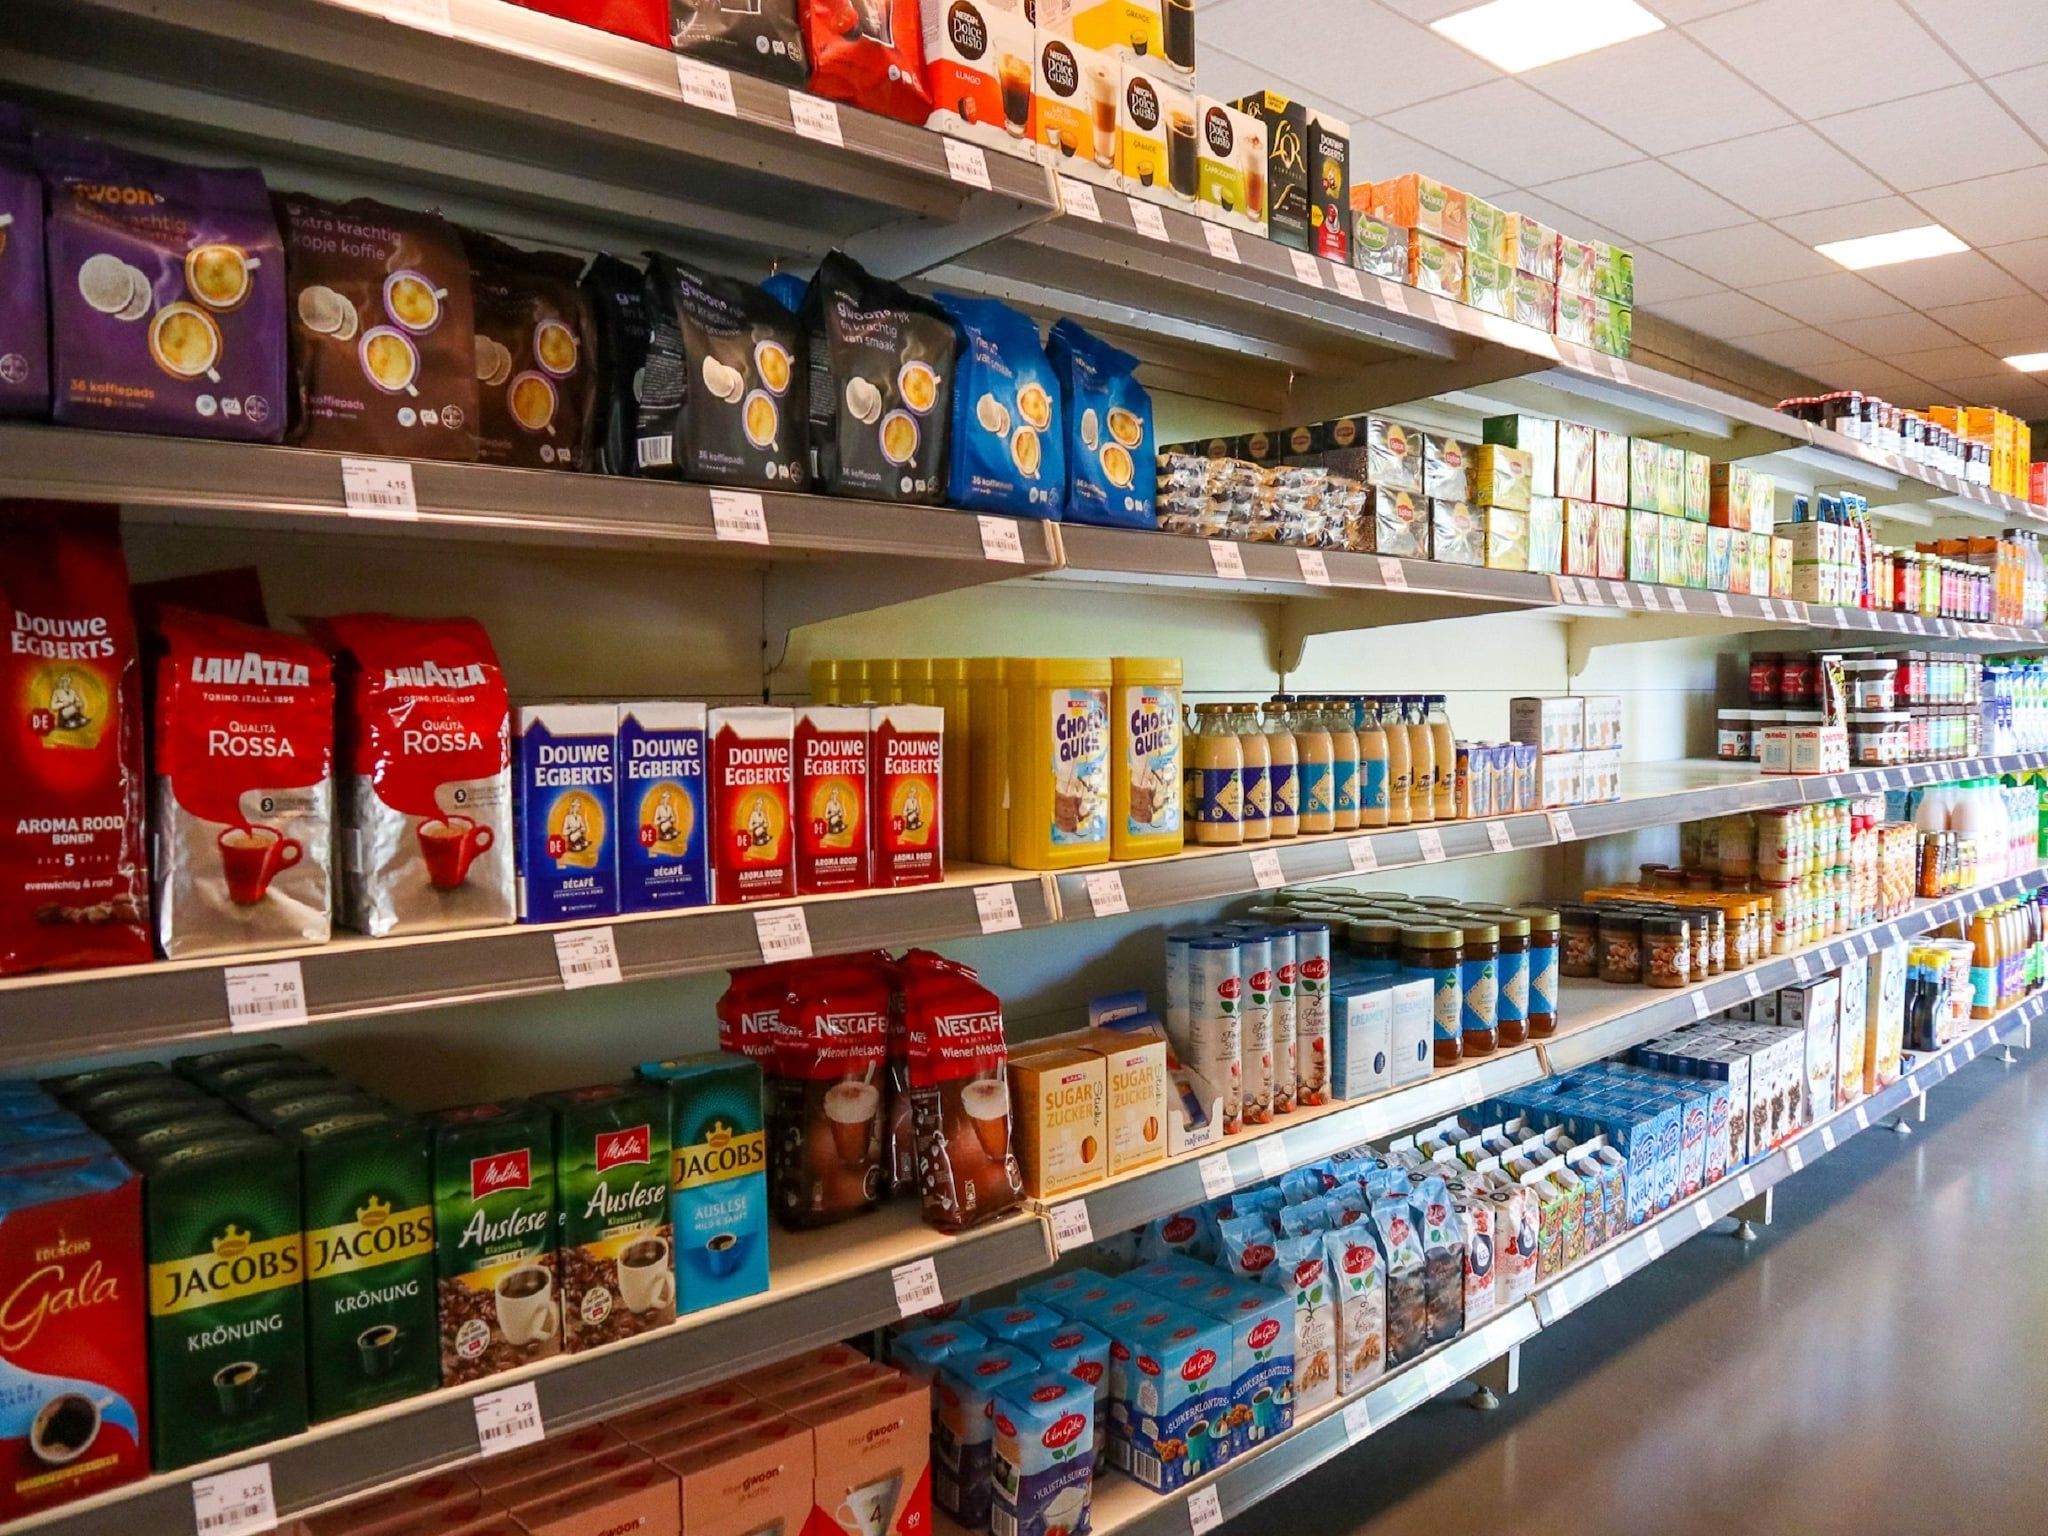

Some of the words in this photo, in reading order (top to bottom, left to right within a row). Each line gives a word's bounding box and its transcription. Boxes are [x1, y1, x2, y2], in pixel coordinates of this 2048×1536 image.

[953, 18, 982, 40] Dolce
[954, 31, 982, 51] Gusto
[955, 70, 981, 86] LUNGO
[1048, 59, 1073, 80] Dolce
[1048, 69, 1073, 87] Gusto
[1131, 94, 1155, 112] Dolce
[1132, 104, 1156, 122] Gusto
[1209, 122, 1229, 140] Dolce
[1209, 133, 1231, 151] Gusto
[337, 220, 402, 243] krachtig
[341, 240, 386, 261] koffie
[864, 335, 897, 352] smaak
[90, 381, 156, 402] koffiepads
[15, 610, 108, 638] DOUWE
[11, 630, 116, 660] EGBERTS
[191, 652, 311, 688] LAVAZZA
[383, 660, 487, 691] LAVAZZA
[208, 730, 296, 758] ROSSA
[403, 730, 483, 755] ROSSA
[632, 738, 699, 758] DOUWE
[807, 739, 864, 757] DOUWE
[888, 739, 939, 757] DOUWE
[539, 745, 609, 765] DOUWE
[729, 748, 789, 766] DOUWE
[535, 766, 613, 787] EGBERTS
[628, 759, 701, 779] EGBERTS
[725, 767, 791, 786] EGBERTS
[804, 758, 866, 776] EGBERTS
[885, 758, 940, 775] EGBERTS
[16, 816, 79, 834] AROMA
[83, 815, 124, 831] ROOD
[52, 833, 95, 846] BONEN
[64, 853, 76, 867] 5
[653, 864, 684, 877] DÉCAFÉ
[24, 878, 81, 892] evenwichtig
[562, 875, 595, 889] DÉCAFÉ
[818, 1047, 849, 1059] Wiener
[850, 1045, 886, 1058] Melang
[940, 1046, 974, 1058] Wiener
[976, 1043, 1008, 1057] Melang
[1112, 1065, 1154, 1092] SUGAR
[1045, 1084, 1092, 1111] SUGAR
[1114, 1087, 1156, 1110] ZUCKER
[1046, 1104, 1094, 1129] ZUCKER
[674, 1140, 764, 1185] JACOBS
[584, 1181, 666, 1219] Auslese
[457, 1206, 548, 1249] Auslese
[314, 1216, 432, 1273] JACOBS
[165, 1246, 299, 1308] JACOBS
[334, 1279, 420, 1315] KRÖNUNG
[187, 1313, 284, 1352] KRÖNUNG
[866, 1421, 900, 1443] gwoon
[742, 1466, 780, 1493] gwoon
[869, 1503, 882, 1524] 4
[907, 1511, 921, 1526] 80
